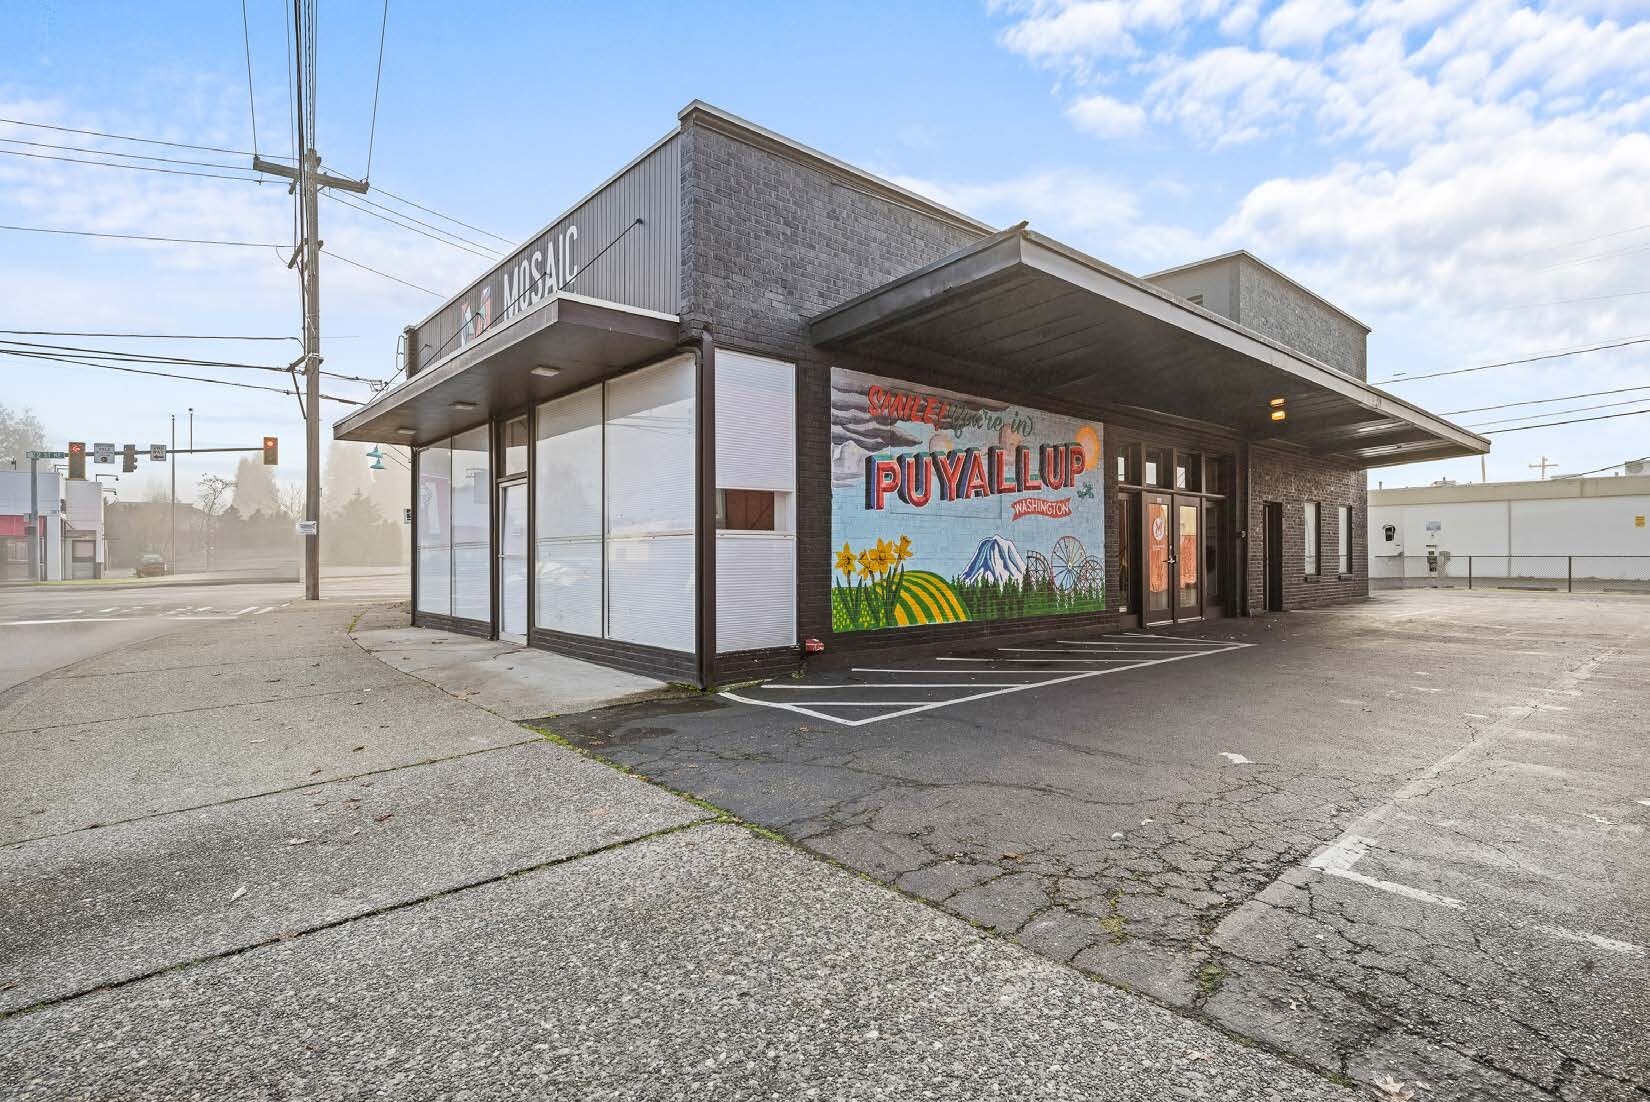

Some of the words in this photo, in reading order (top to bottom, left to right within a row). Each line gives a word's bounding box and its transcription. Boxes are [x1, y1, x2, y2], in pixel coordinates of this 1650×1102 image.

[504, 225, 578, 320] MOSAIC
[868, 385, 950, 431] SMILE!
[1011, 410, 1033, 437] in
[865, 441, 1085, 510] PUYALLUP
[1014, 498, 1069, 515] WASHINGTON
